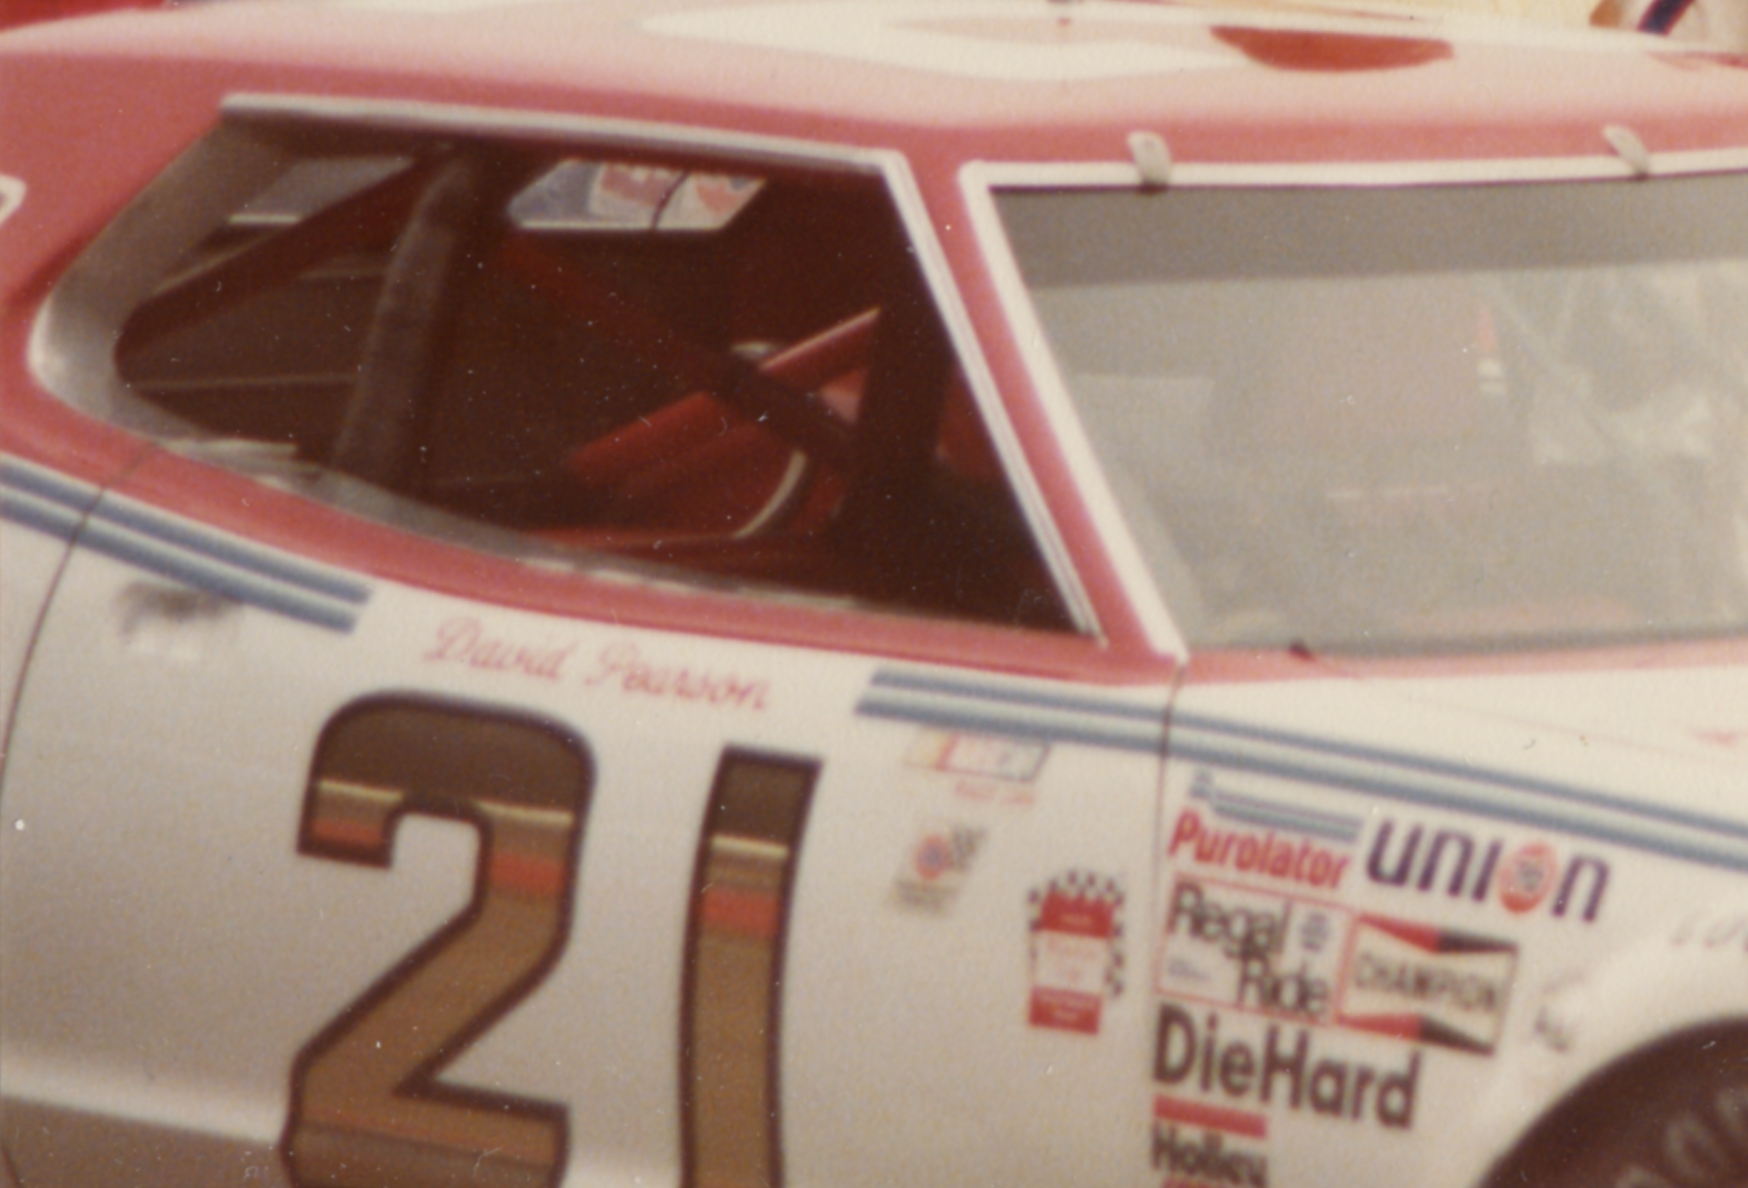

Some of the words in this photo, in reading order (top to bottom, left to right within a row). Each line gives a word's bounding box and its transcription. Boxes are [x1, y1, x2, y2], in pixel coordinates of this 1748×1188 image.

[422, 615, 580, 682] David
[583, 640, 770, 711] Pearson
[1167, 807, 1352, 891] Purolator
[280, 688, 823, 1188] 21
[1166, 878, 1292, 961] Regal
[1237, 950, 1329, 1016] Ride
[1355, 950, 1500, 1014] CHAMPION
[1153, 1001, 1421, 1131] DieHard
